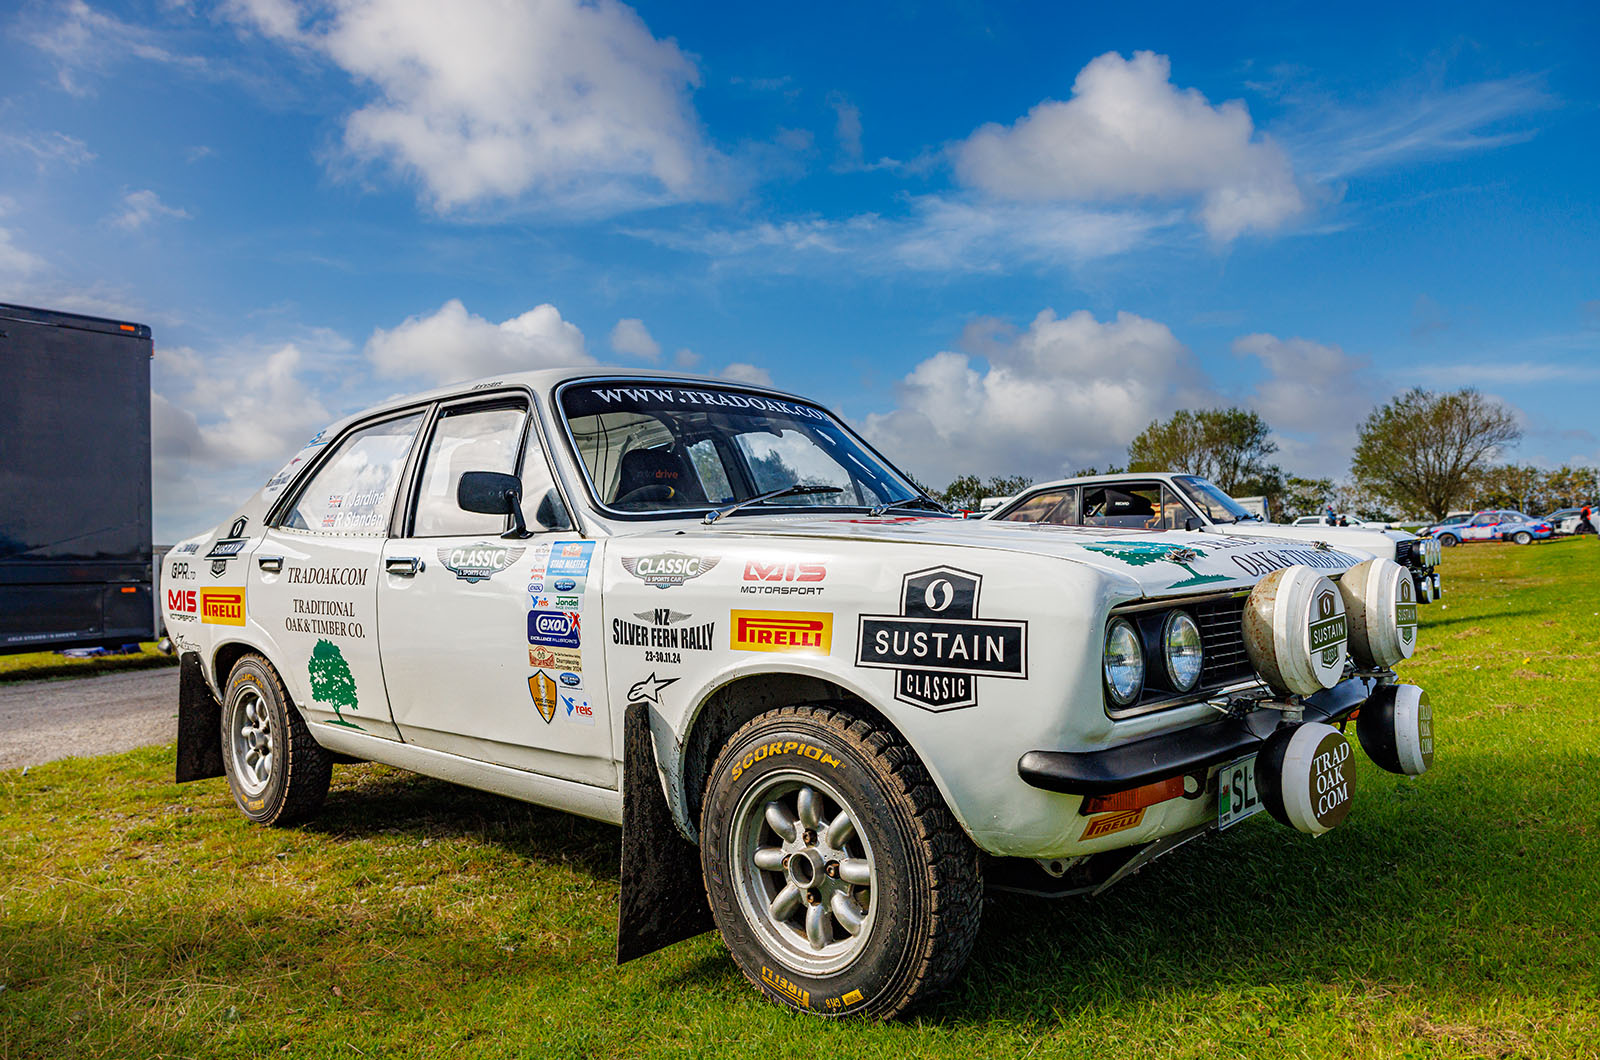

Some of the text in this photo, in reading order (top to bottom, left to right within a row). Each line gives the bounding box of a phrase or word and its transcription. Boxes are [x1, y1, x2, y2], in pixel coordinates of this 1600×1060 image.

[450, 549, 506, 568] CLASSIC
[637, 557, 699, 576] CLASSIC
[1231, 552, 1276, 577] OAK
[288, 567, 368, 586] TRADOAK.COM
[743, 560, 828, 582] MIS
[168, 589, 197, 613] MIS
[740, 586, 825, 596] MOTORSPORT
[203, 594, 241, 619] PIRELLI
[293, 599, 355, 617] TRADITIONAL
[654, 608, 670, 626] NZ
[286, 617, 366, 638] OAK & TIMBER CO.
[612, 618, 715, 651] SILVER FERN RALLY
[738, 617, 824, 647] PIRELLI
[1313, 622, 1344, 645] SUSTAIN
[645, 651, 681, 664] 23-30.11.24
[875, 630, 1005, 662] SUSTAIN
[907, 674, 965, 701] CLASSIC
[575, 701, 593, 716] reis
[732, 741, 843, 781] SCORPION
[1313, 742, 1350, 777] TRAD
[1316, 765, 1345, 795] OAK
[1317, 784, 1349, 818] .COM
[1086, 808, 1142, 836] PIRELLI
[761, 965, 810, 1008] PIRELLI
